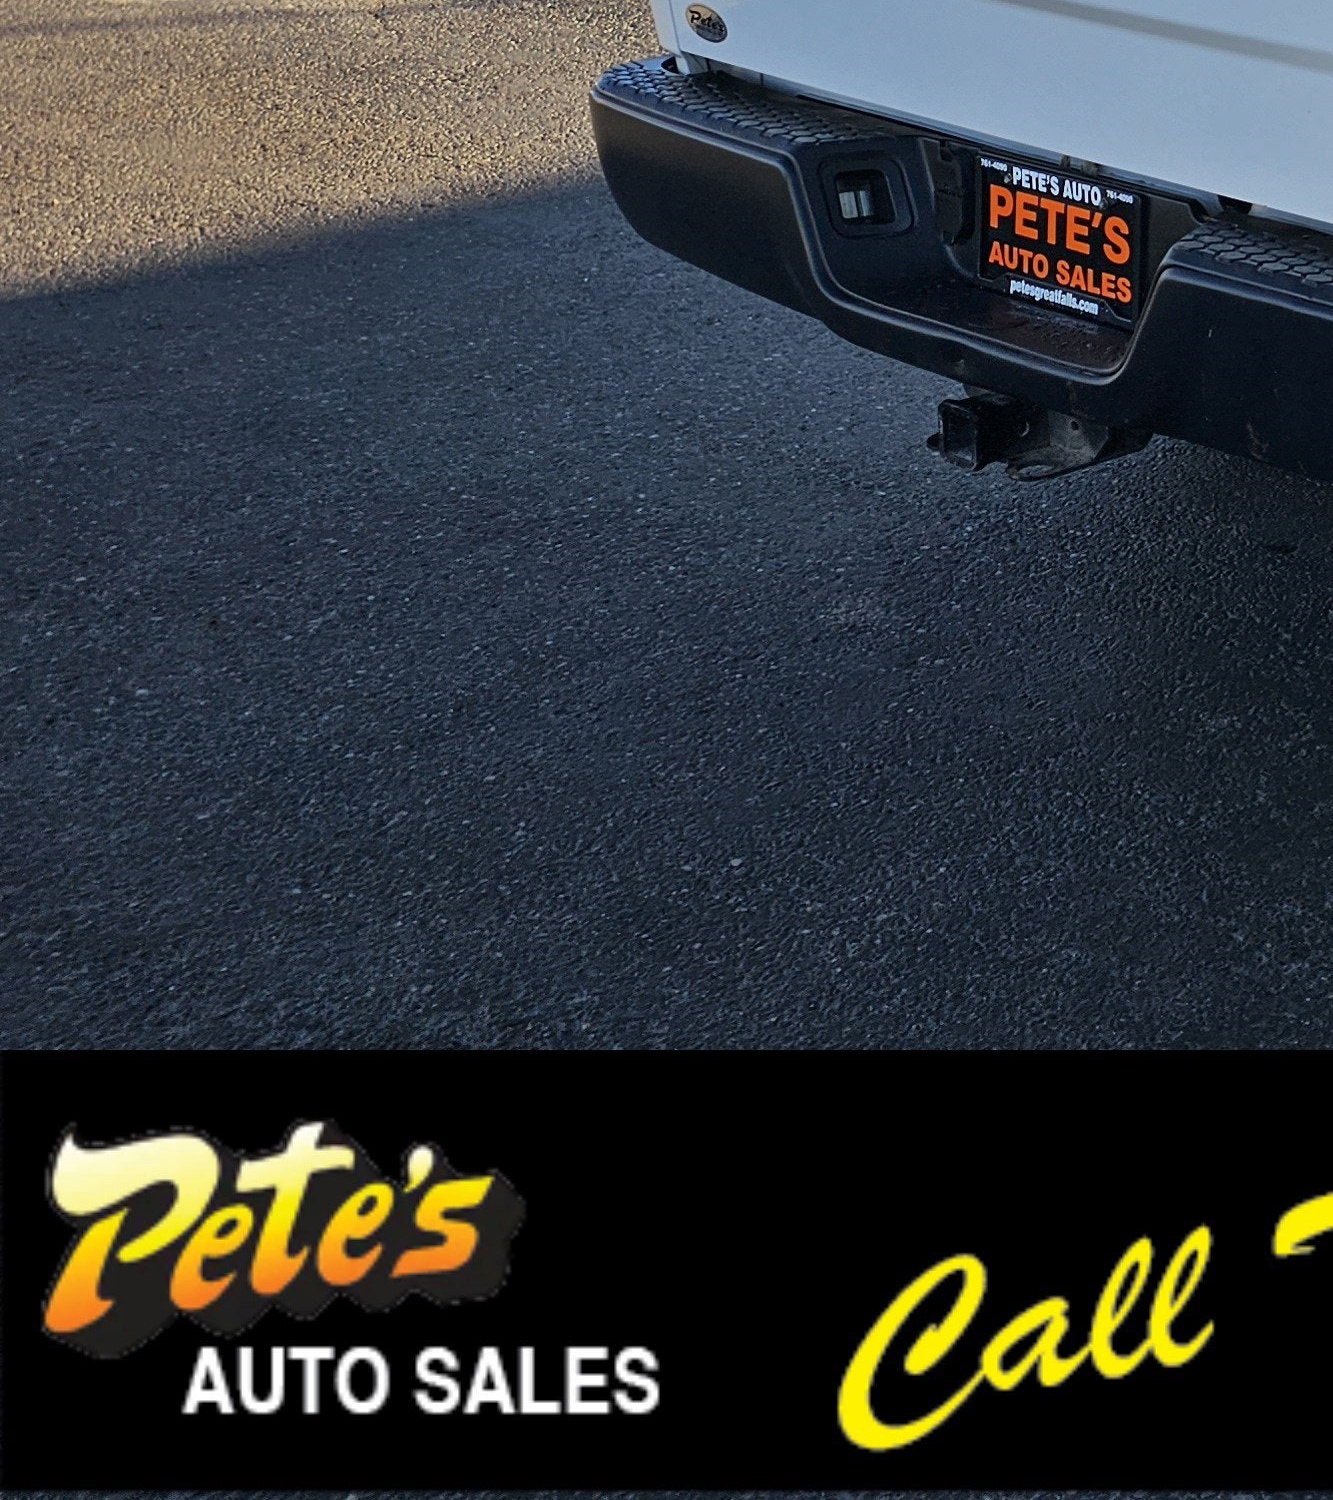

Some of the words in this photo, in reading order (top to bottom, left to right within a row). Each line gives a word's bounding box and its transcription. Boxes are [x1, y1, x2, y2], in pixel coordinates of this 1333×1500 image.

[1012, 166, 1060, 196] PETE'S
[1063, 179, 1102, 206] AUTO
[989, 183, 1130, 264] PETE'S
[988, 240, 1049, 279] AUTO
[1056, 259, 1132, 303] SALES
[1010, 279, 1099, 315] petesgreatfalls.com
